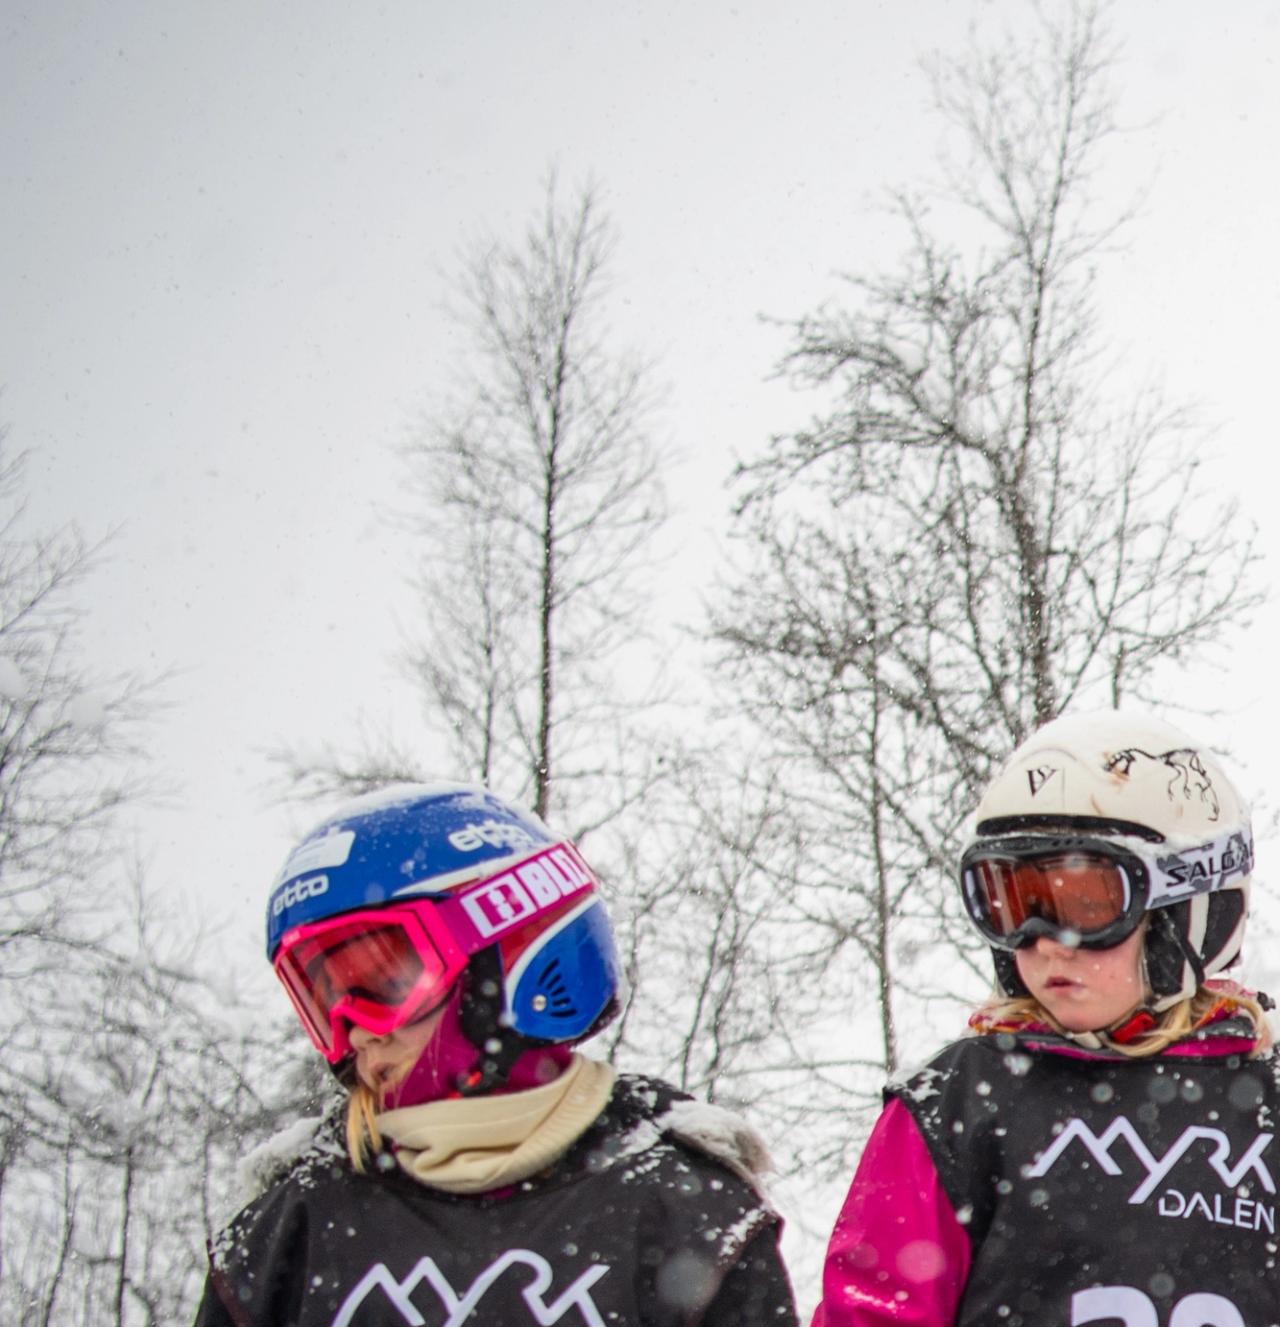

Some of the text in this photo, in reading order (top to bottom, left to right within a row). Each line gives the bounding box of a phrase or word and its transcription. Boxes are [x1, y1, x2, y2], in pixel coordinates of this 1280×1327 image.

[273, 873, 329, 916] etto
[1029, 1115, 1277, 1204] MYRK
[1158, 1189, 1276, 1234] DALEN
